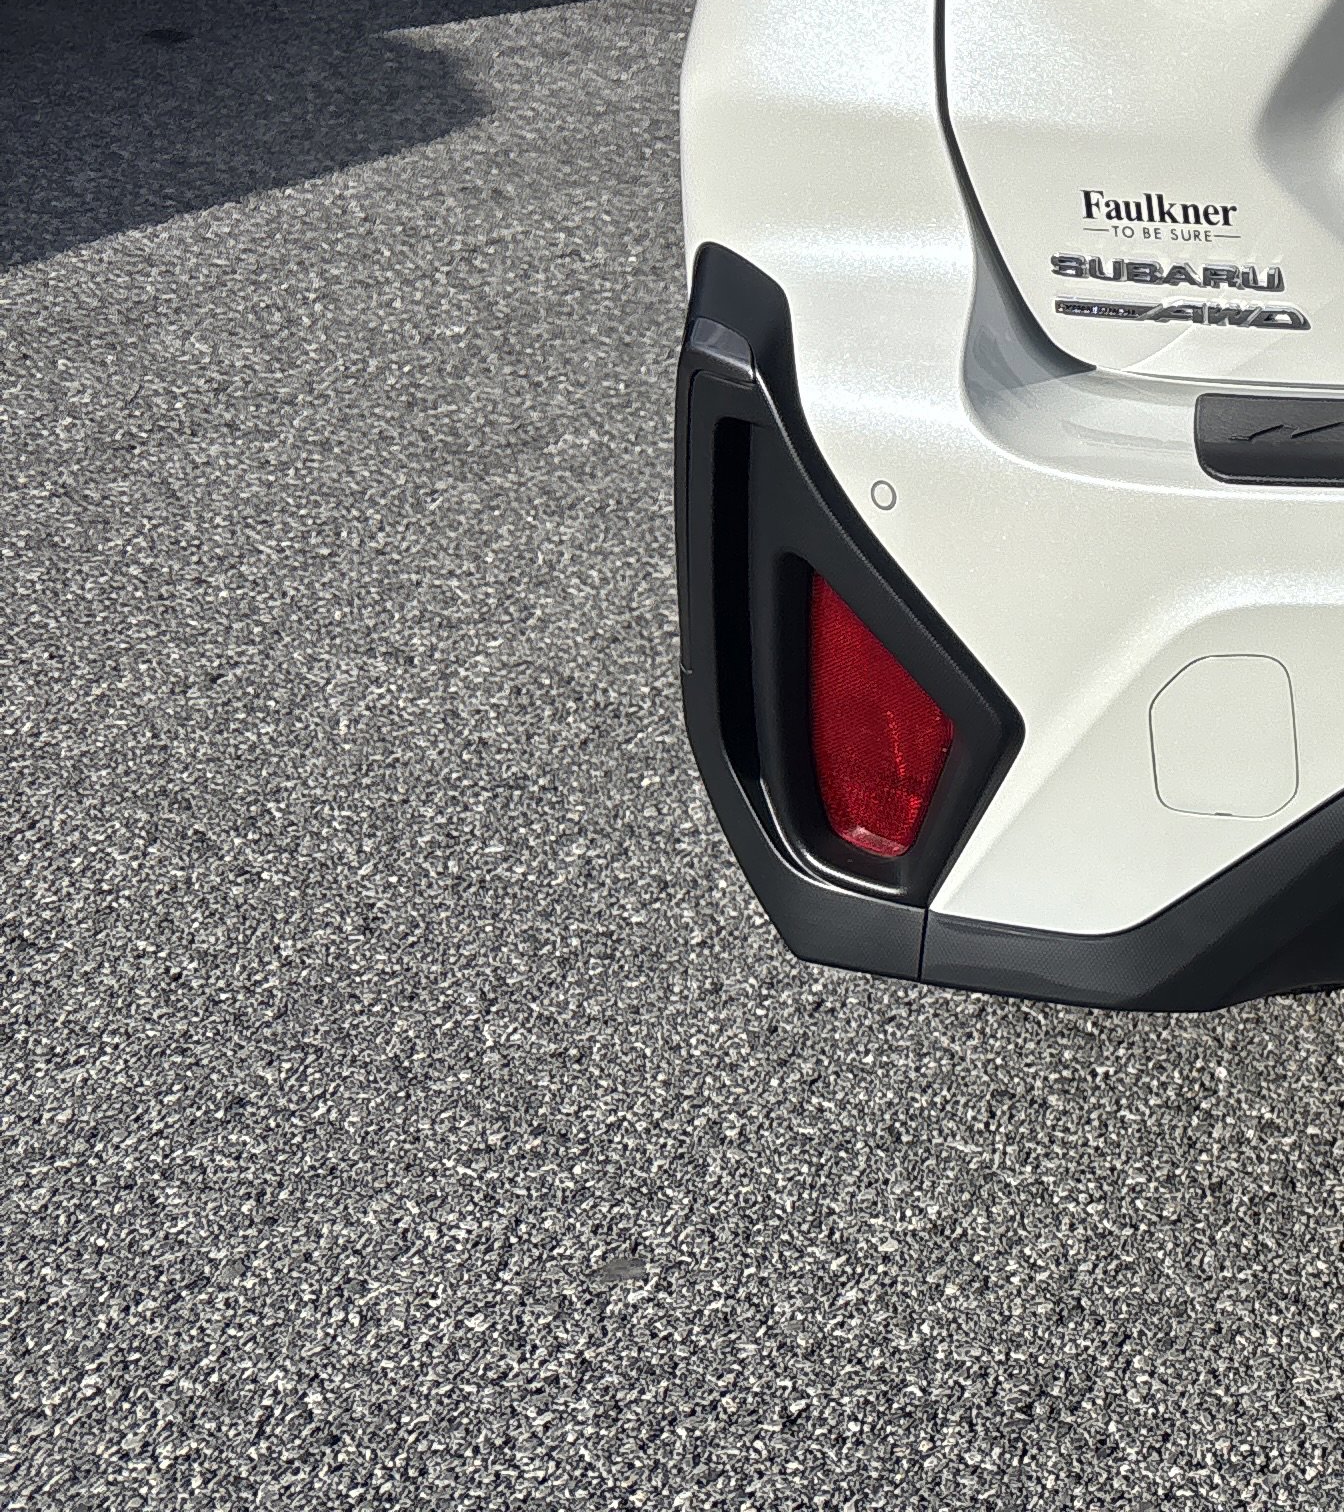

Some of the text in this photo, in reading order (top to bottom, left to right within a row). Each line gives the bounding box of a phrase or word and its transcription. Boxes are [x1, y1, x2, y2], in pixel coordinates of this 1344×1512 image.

[1081, 189, 1238, 226] Faulkner
[1111, 225, 1213, 243] TO BE SURE
[1050, 251, 1286, 292] SUBARU
